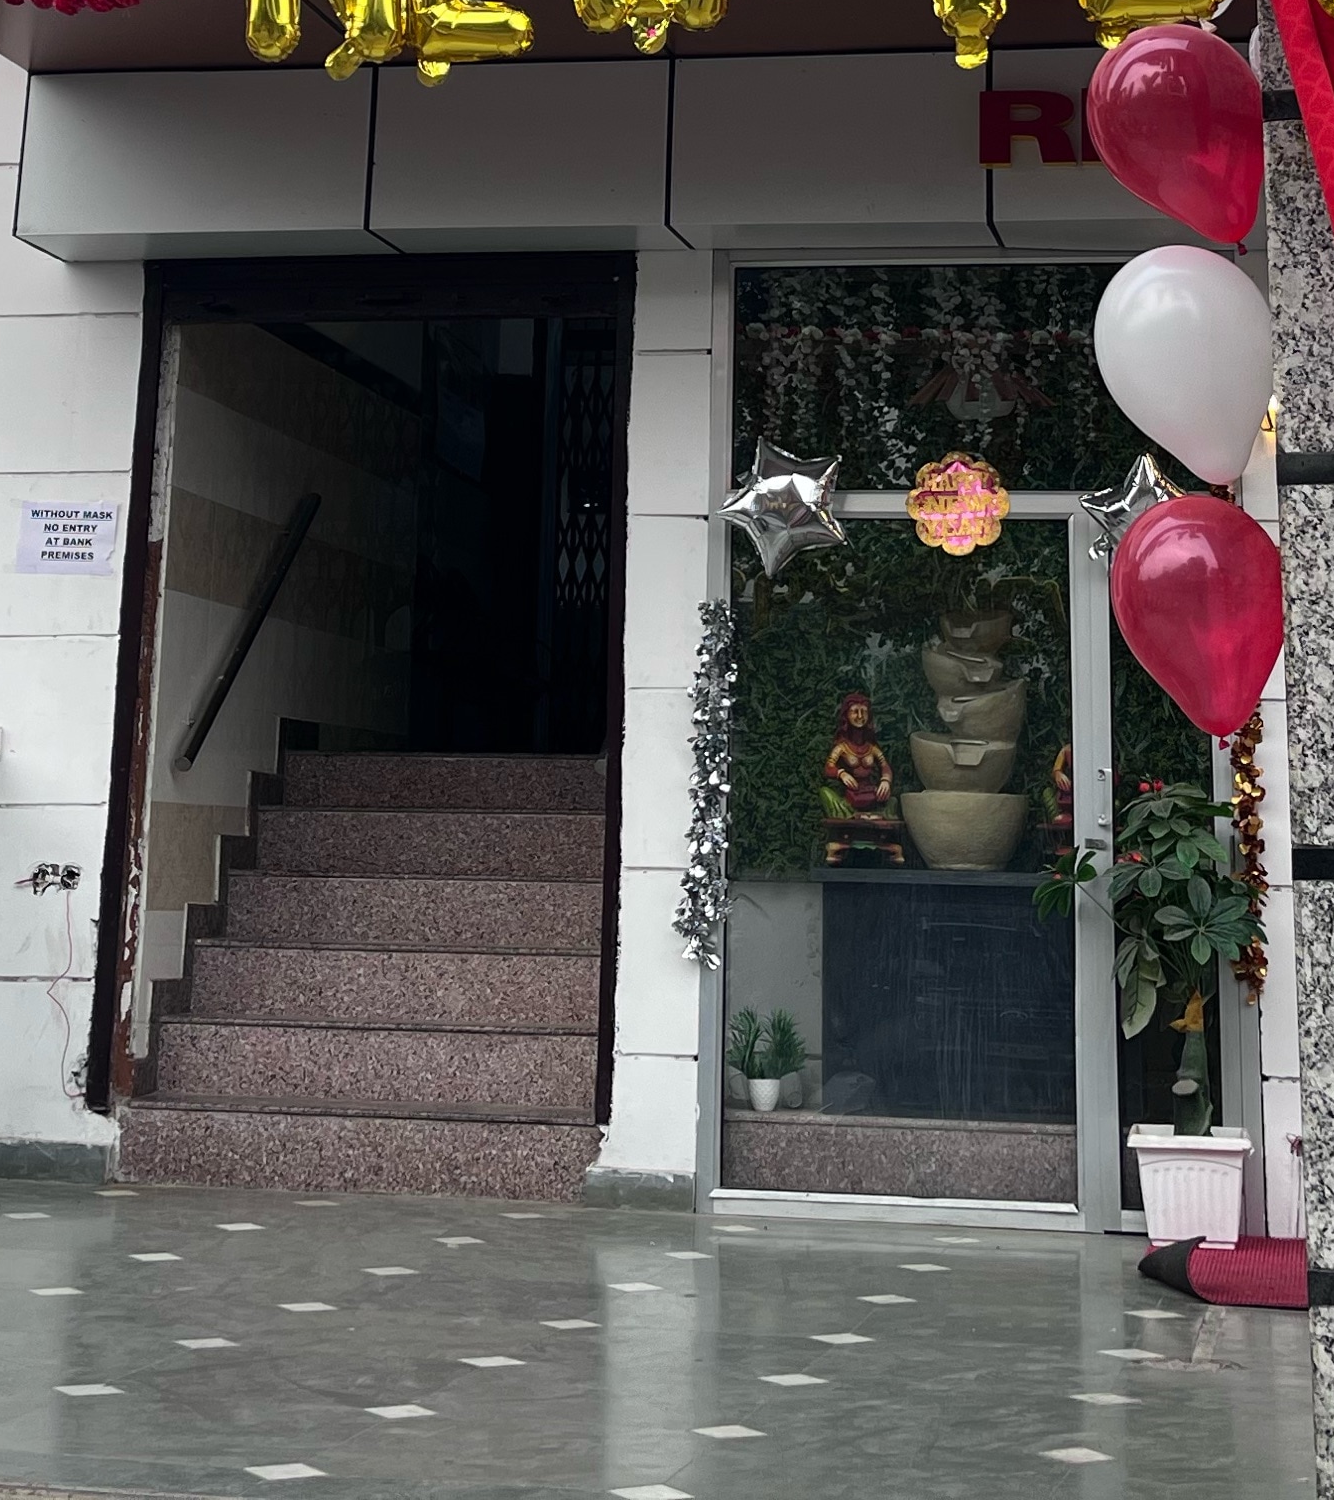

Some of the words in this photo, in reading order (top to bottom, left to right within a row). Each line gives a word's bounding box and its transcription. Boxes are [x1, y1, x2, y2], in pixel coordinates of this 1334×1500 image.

[31, 509, 80, 519] WITHOUT
[82, 510, 113, 520] MASK
[44, 523, 59, 532] NO
[62, 524, 98, 533] ENTRY
[45, 537, 60, 546] AT
[62, 538, 93, 547] BANK
[41, 551, 94, 560] PREMISES
